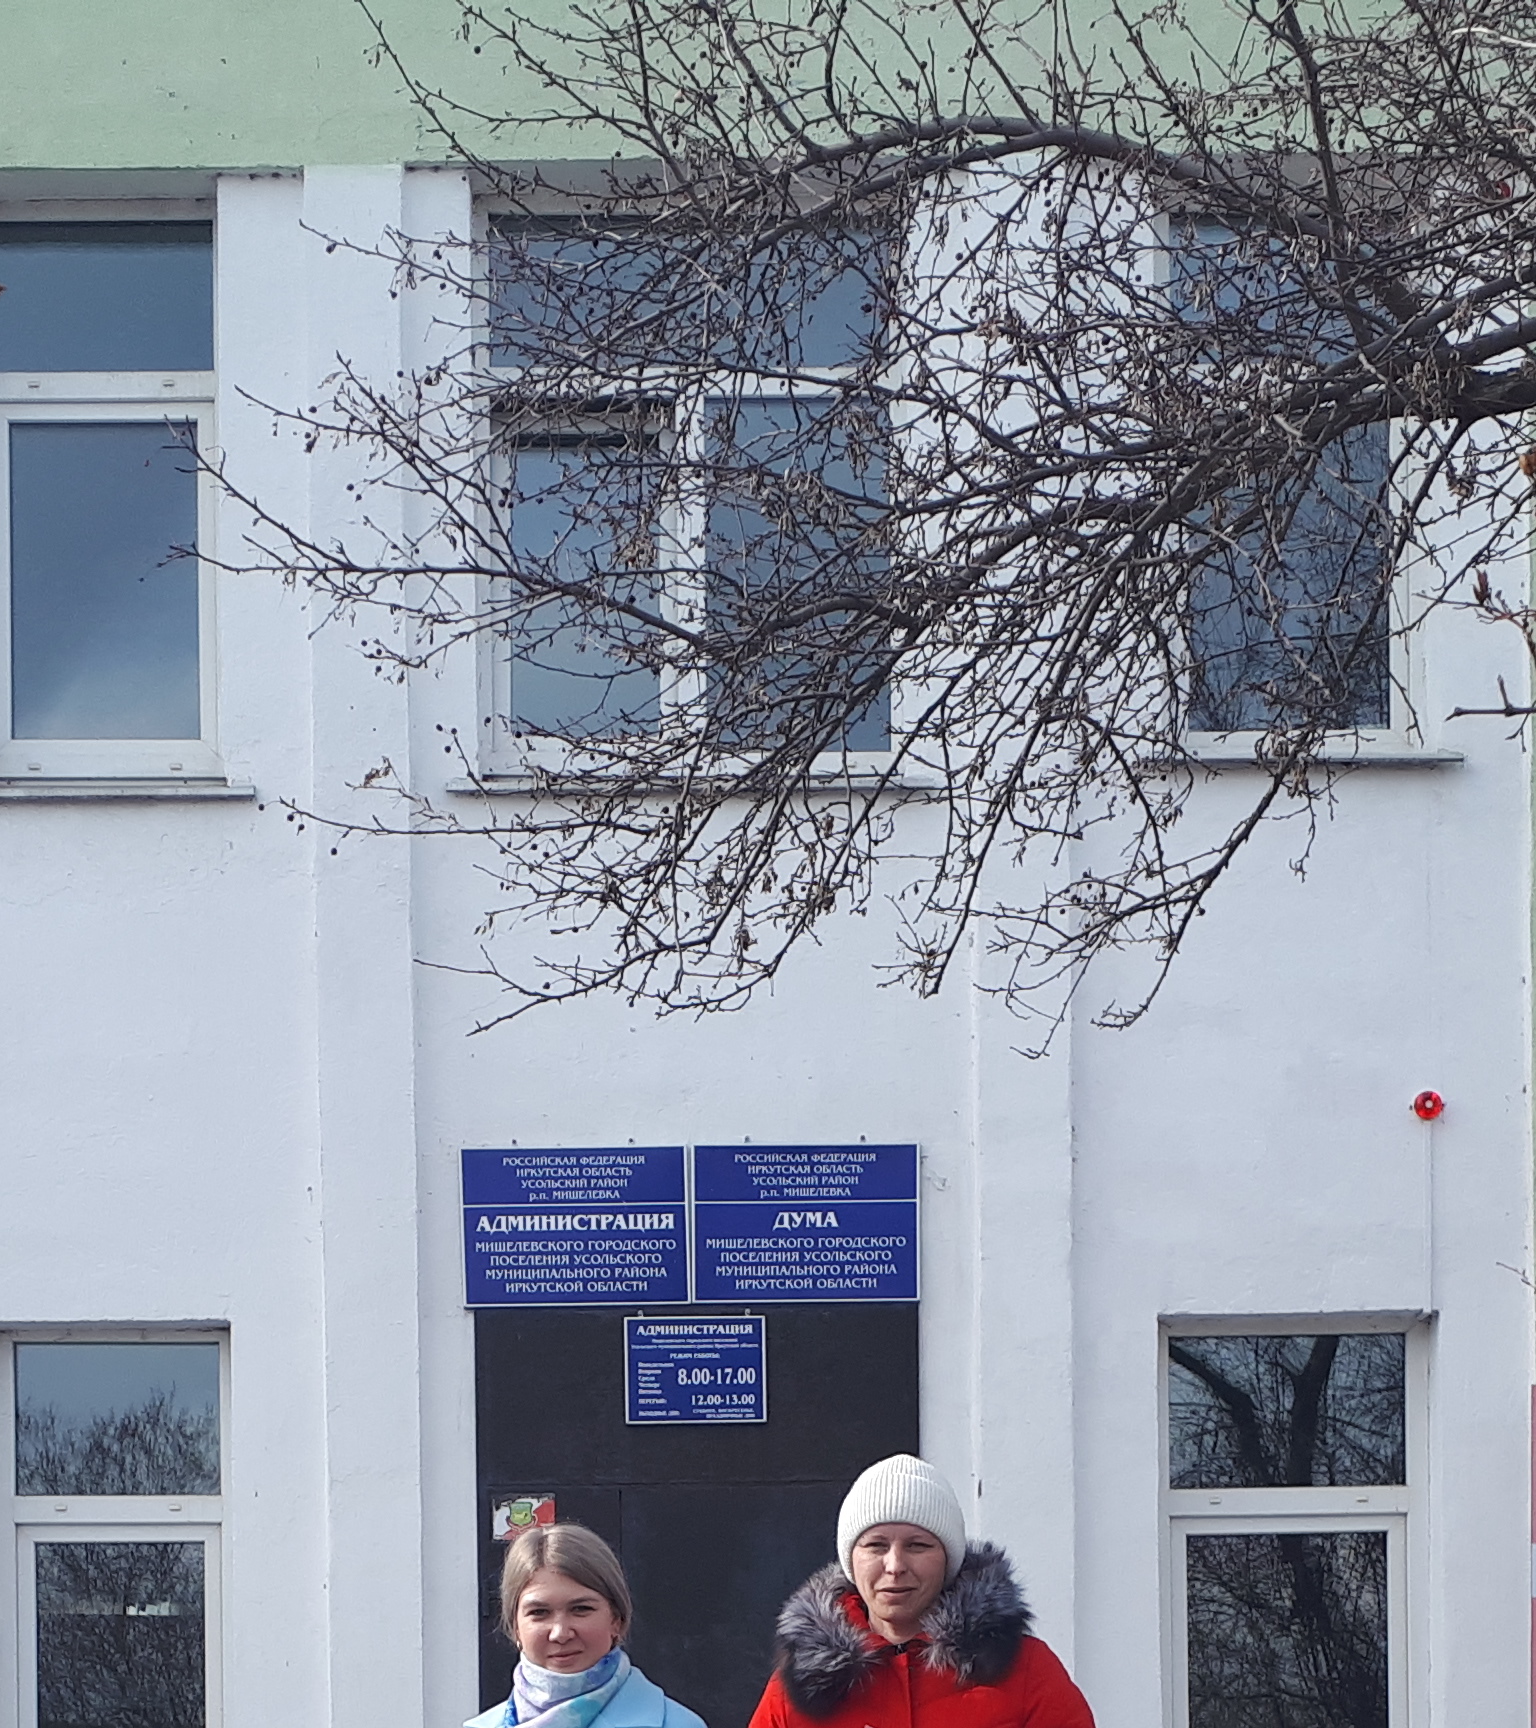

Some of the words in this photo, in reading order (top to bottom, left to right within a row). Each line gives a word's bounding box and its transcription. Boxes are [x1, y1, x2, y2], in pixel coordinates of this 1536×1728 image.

[503, 1156, 577, 1166] РОССИЙСКАЯ
[579, 1155, 645, 1166] ФЕДЕРАЦИЯ
[734, 1153, 808, 1164] РОССИЙСКАЯ
[811, 1153, 877, 1163] ФЕДЕРАЦИЯ
[515, 1167, 579, 1177] ИРКУТСКАЯ
[582, 1167, 633, 1177] ОБЛАСТЬ
[747, 1165, 811, 1175] ИРКУТСКАЯ
[813, 1164, 864, 1174] ОБЛАСТЬ
[521, 1178, 588, 1189] УСОЛЬСКИЙ
[590, 1178, 628, 1188] РАЙОН
[752, 1176, 819, 1186] УСОЛЬСКИЙ
[822, 1176, 859, 1185] РАЙОН
[529, 1192, 549, 1202] р.п.
[552, 1190, 620, 1200] МИШЕЛЕВКА
[760, 1189, 780, 1199] р.п.
[783, 1187, 851, 1197] МИШЕЛЕВКА
[475, 1213, 675, 1236] АДМИНИСТРАЦИЯ
[772, 1211, 839, 1232] ДУМА
[475, 1241, 584, 1253] МИШЕЛЕВСКОГО
[588, 1239, 677, 1251] ГОРОДСКОГО
[705, 1238, 814, 1249] МИШЕЛЕВСКОГО
[818, 1236, 907, 1248] ГОРОДСКОГО
[490, 1254, 570, 1267] ПОСЕЛЕНИЯ
[573, 1253, 662, 1265] УСОЛЬСКОГО
[720, 1251, 799, 1263] ПОСЕЛЕНИЯ
[804, 1250, 892, 1262] УСОЛЬСКОГО
[485, 1268, 611, 1280] МУНИЦИПАЛЬНОГО
[614, 1266, 668, 1278] РАЙОНА
[715, 1265, 841, 1277] МУНИЦИПАЛЬНОГО
[844, 1263, 898, 1275] РАЙОНА
[505, 1281, 583, 1293] ИРКУТСКОЙ
[587, 1281, 648, 1292] ОБЛАСТИ
[735, 1278, 813, 1290] ИРКУТСКОЙ
[817, 1277, 877, 1289] ОБЛАСТИ
[636, 1324, 753, 1336] АДМИНИСТРАЦИЯ
[677, 1367, 756, 1385] 8.00-17.00
[691, 1393, 755, 1406] 12.00-13.00
